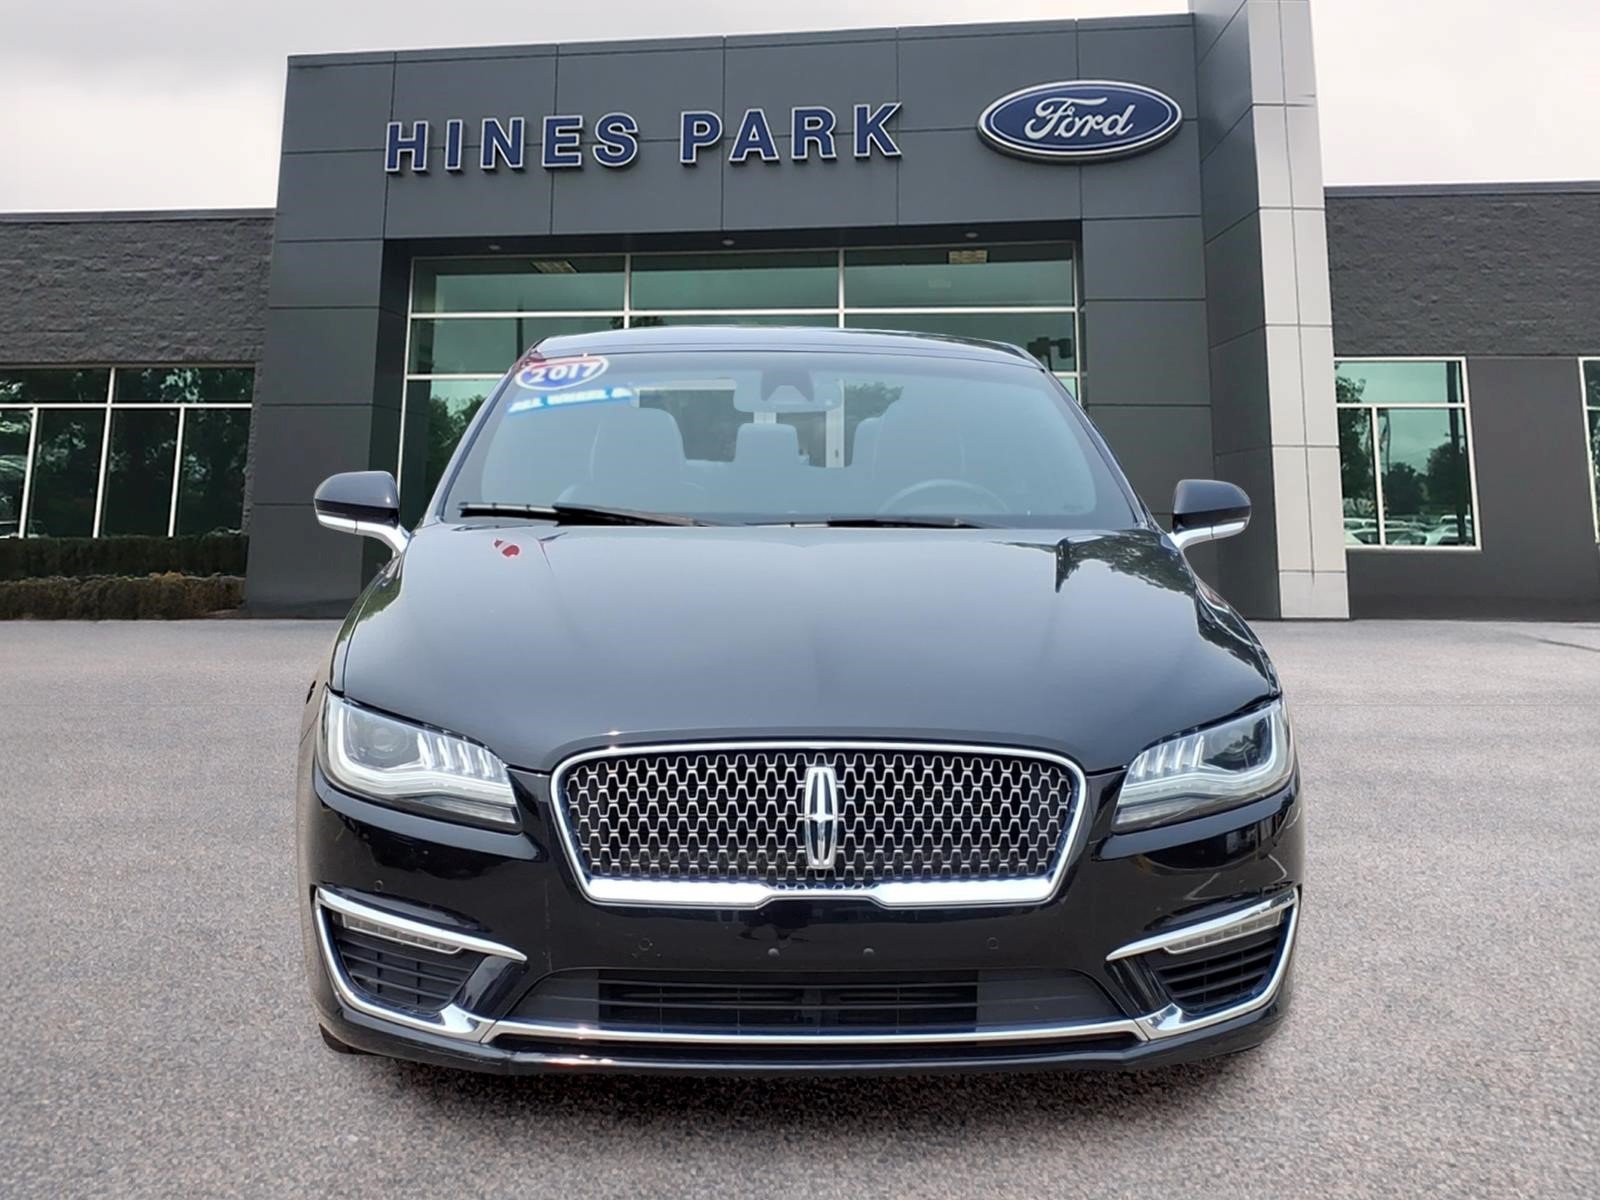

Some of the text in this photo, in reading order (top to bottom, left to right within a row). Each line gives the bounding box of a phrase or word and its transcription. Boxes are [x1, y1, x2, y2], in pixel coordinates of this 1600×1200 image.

[384, 102, 903, 173] HINES PARK
[1024, 97, 1136, 140] Ford
[526, 362, 600, 384] 2017
